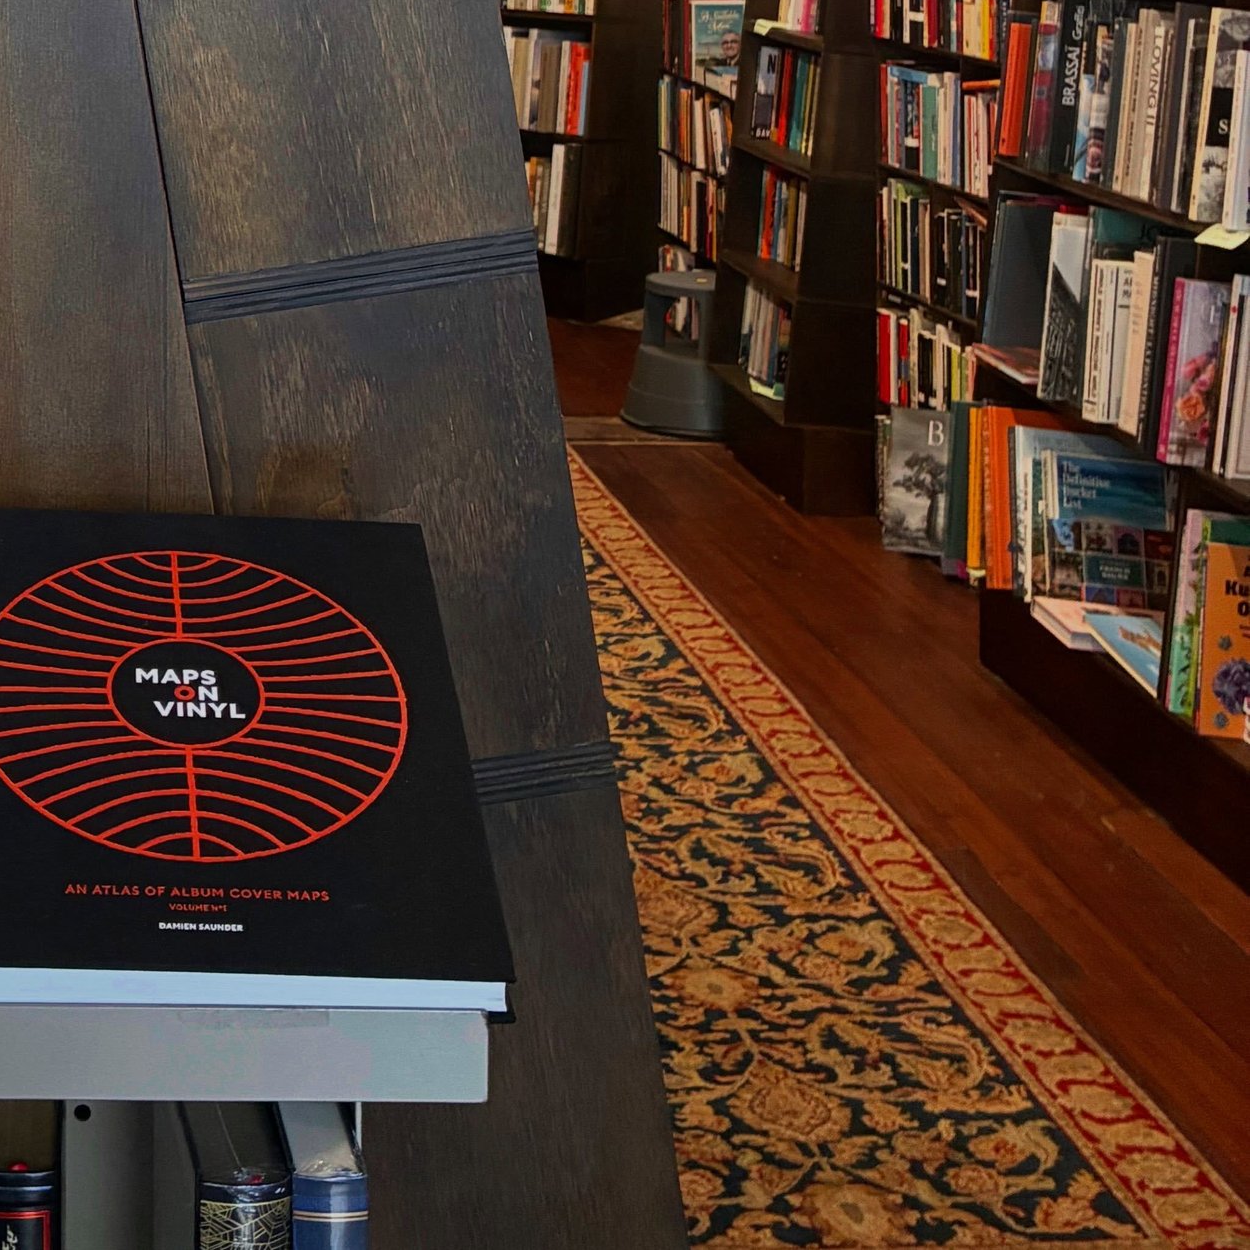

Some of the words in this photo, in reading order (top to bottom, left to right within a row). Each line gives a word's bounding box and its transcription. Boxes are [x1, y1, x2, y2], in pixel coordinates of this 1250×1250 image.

[1058, 45, 1082, 106] BRASSAÏ
[1146, 34, 1164, 109] LOVING
[927, 420, 945, 447] B
[135, 667, 217, 686] MAPS
[174, 685, 219, 702] ON
[153, 701, 246, 719] VINYL
[65, 883, 88, 895] AN
[91, 884, 140, 897] ATLAS
[146, 885, 166, 897] OF
[170, 886, 225, 898] ALBUM
[229, 888, 283, 900] COVER
[287, 889, 330, 902] MAPS
[169, 903, 209, 912] VOLUME
[159, 921, 197, 931] DAMIEN
[198, 922, 244, 932] SAUNDER
